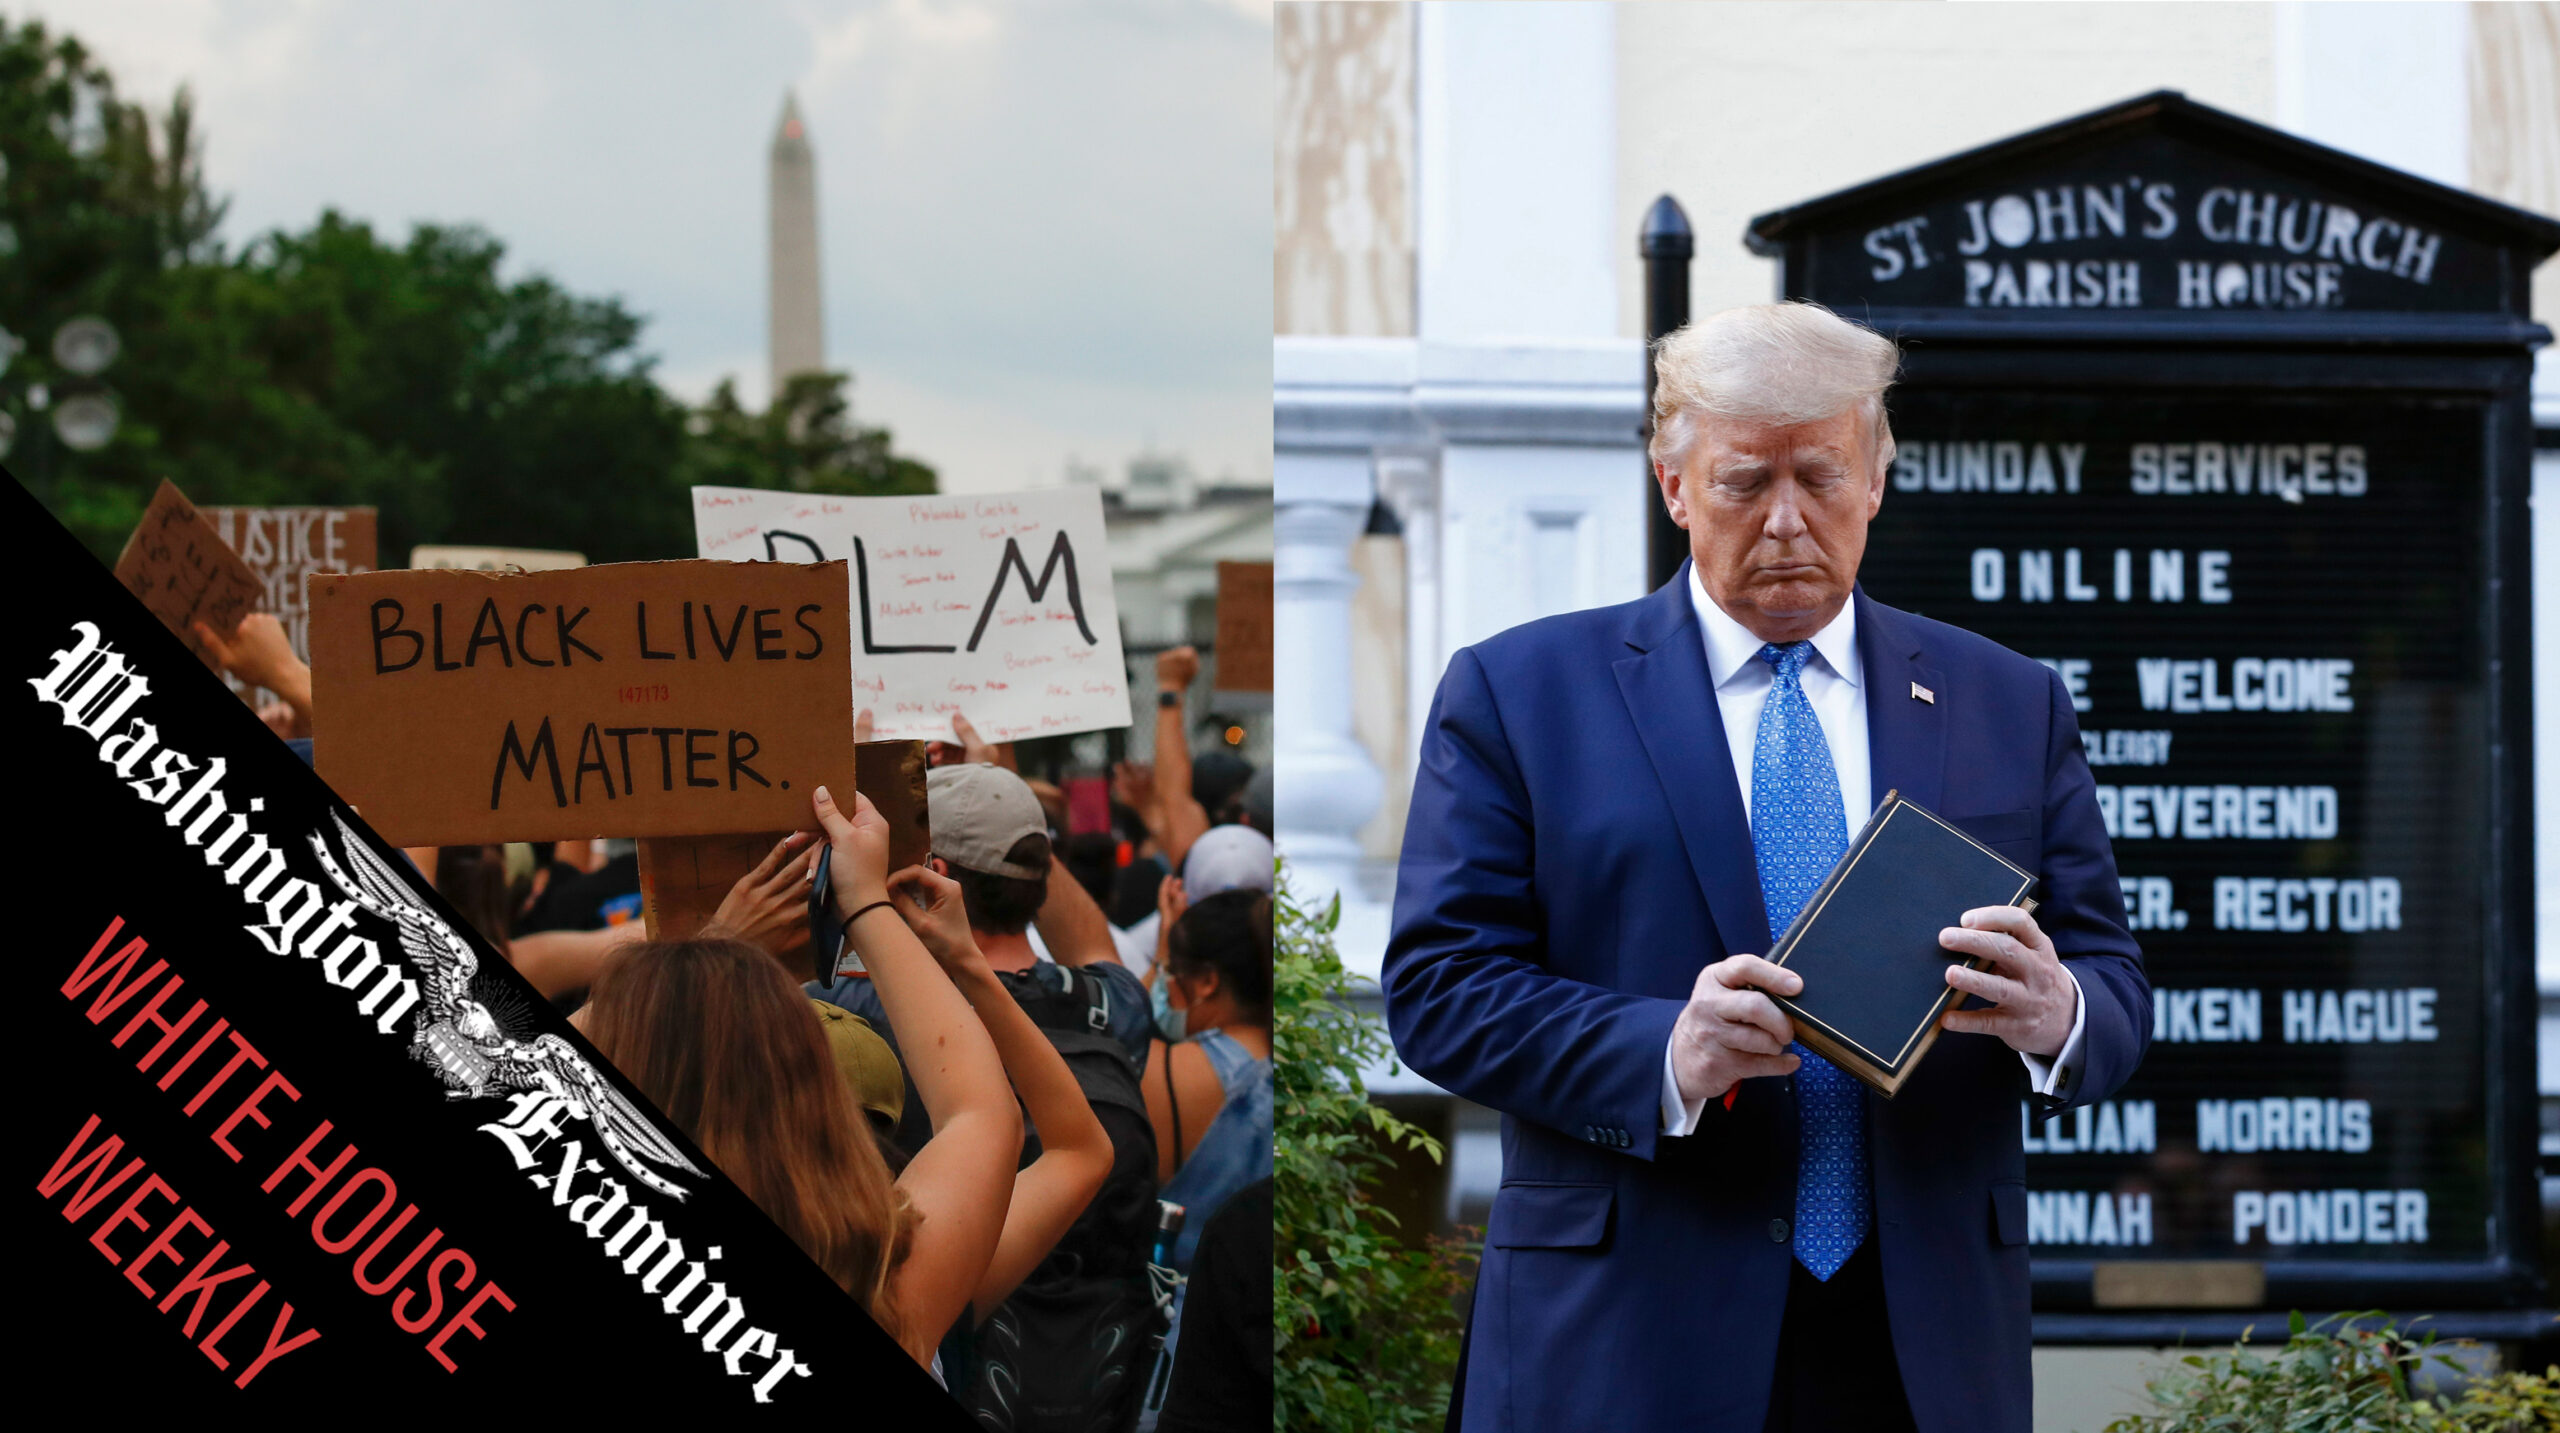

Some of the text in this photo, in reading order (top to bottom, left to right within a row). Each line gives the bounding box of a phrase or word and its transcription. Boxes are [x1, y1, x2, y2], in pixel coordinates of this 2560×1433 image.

[1959, 177, 2178, 256] JOHN'S
[2196, 187, 2441, 284] CHURCH
[1965, 261, 2343, 308] PARISH HOUSE
[1893, 443, 2368, 497] SUNDAY SERVICES
[1971, 549, 2233, 603] ONLINE
[371, 597, 605, 677] BLACK
[638, 601, 825, 664] LIVES
[618, 684, 670, 703] 147173
[2036, 658, 2354, 713] E WELCOME
[491, 716, 791, 811] MATTER.
[2080, 730, 2172, 766] CLERGY
[2096, 786, 2339, 840] REVEREND
[2214, 877, 2402, 932] RECTOR
[2284, 988, 2438, 1043] HAGUE
[2198, 1099, 2373, 1153] MORRIS
[2027, 1190, 2428, 1245] NNAH PONDER
